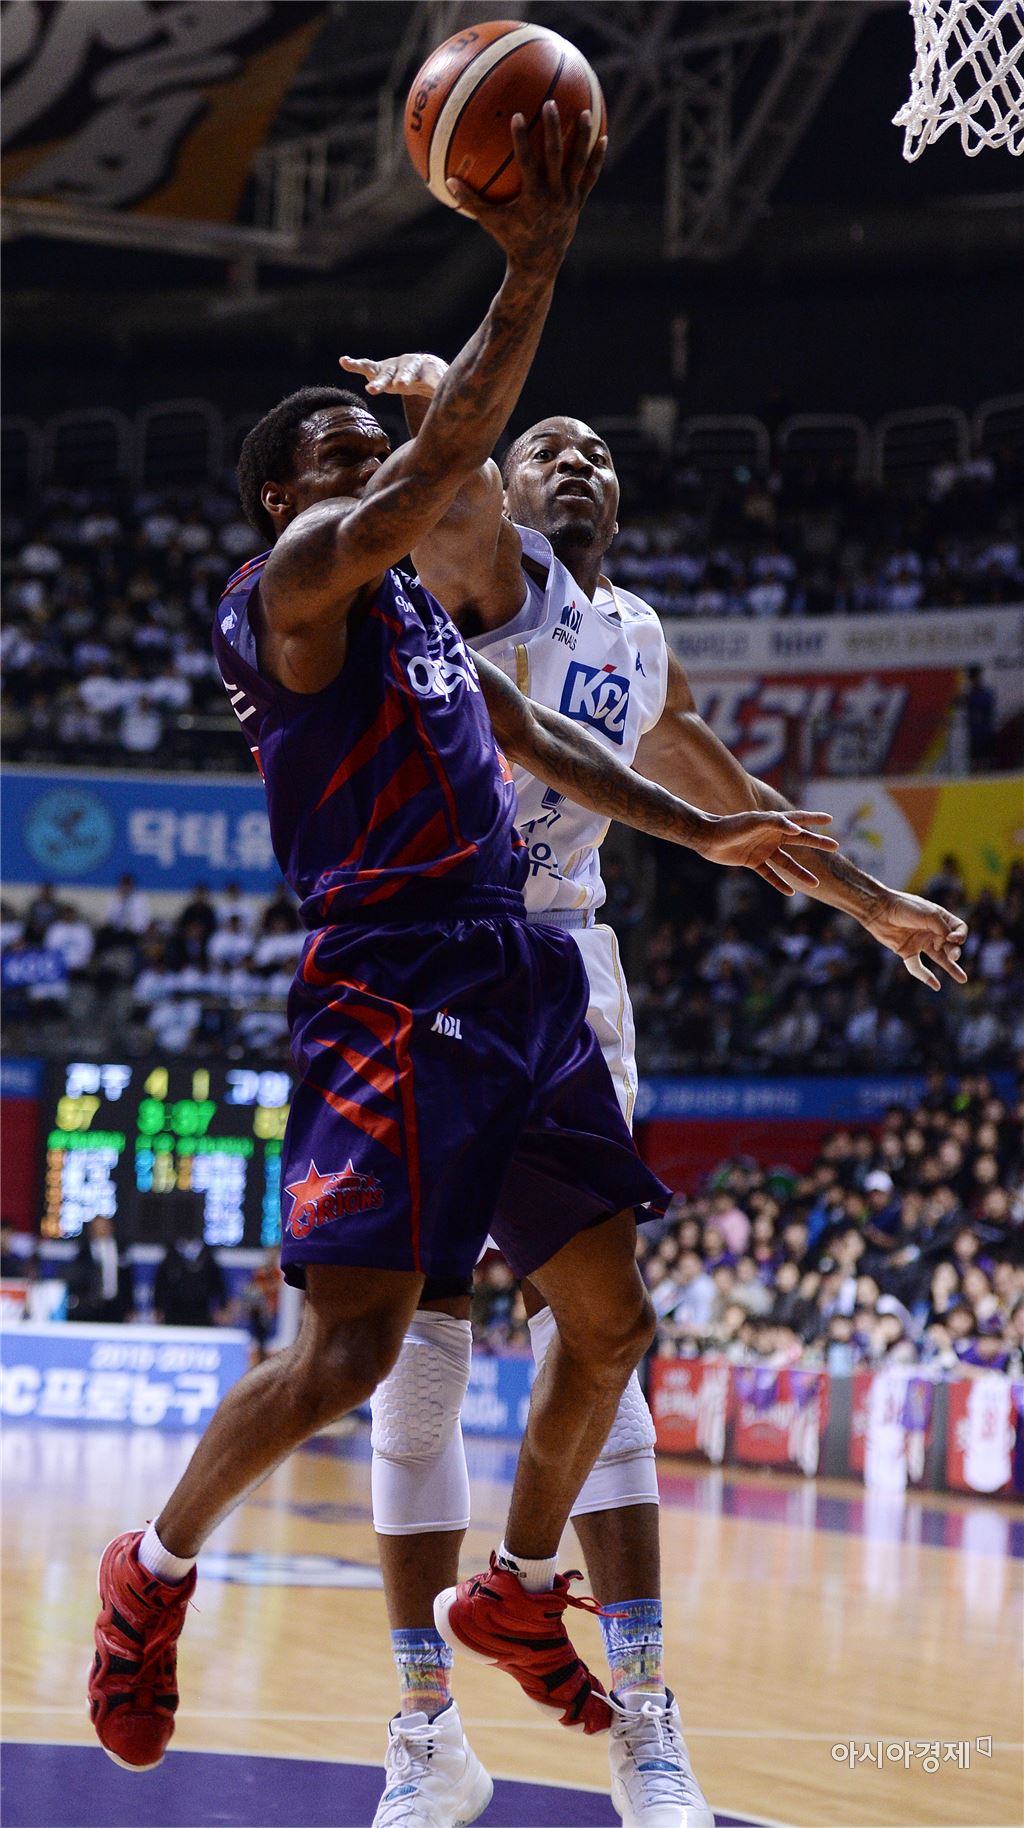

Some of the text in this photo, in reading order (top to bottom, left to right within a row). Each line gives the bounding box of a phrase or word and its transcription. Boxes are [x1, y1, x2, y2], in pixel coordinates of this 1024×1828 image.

[410, 31, 481, 133] mten
[568, 669, 630, 733] KCC
[430, 1009, 463, 1040] KBL
[290, 1188, 384, 1240] ORIONS
[0, 1364, 220, 1427] C프로농구
